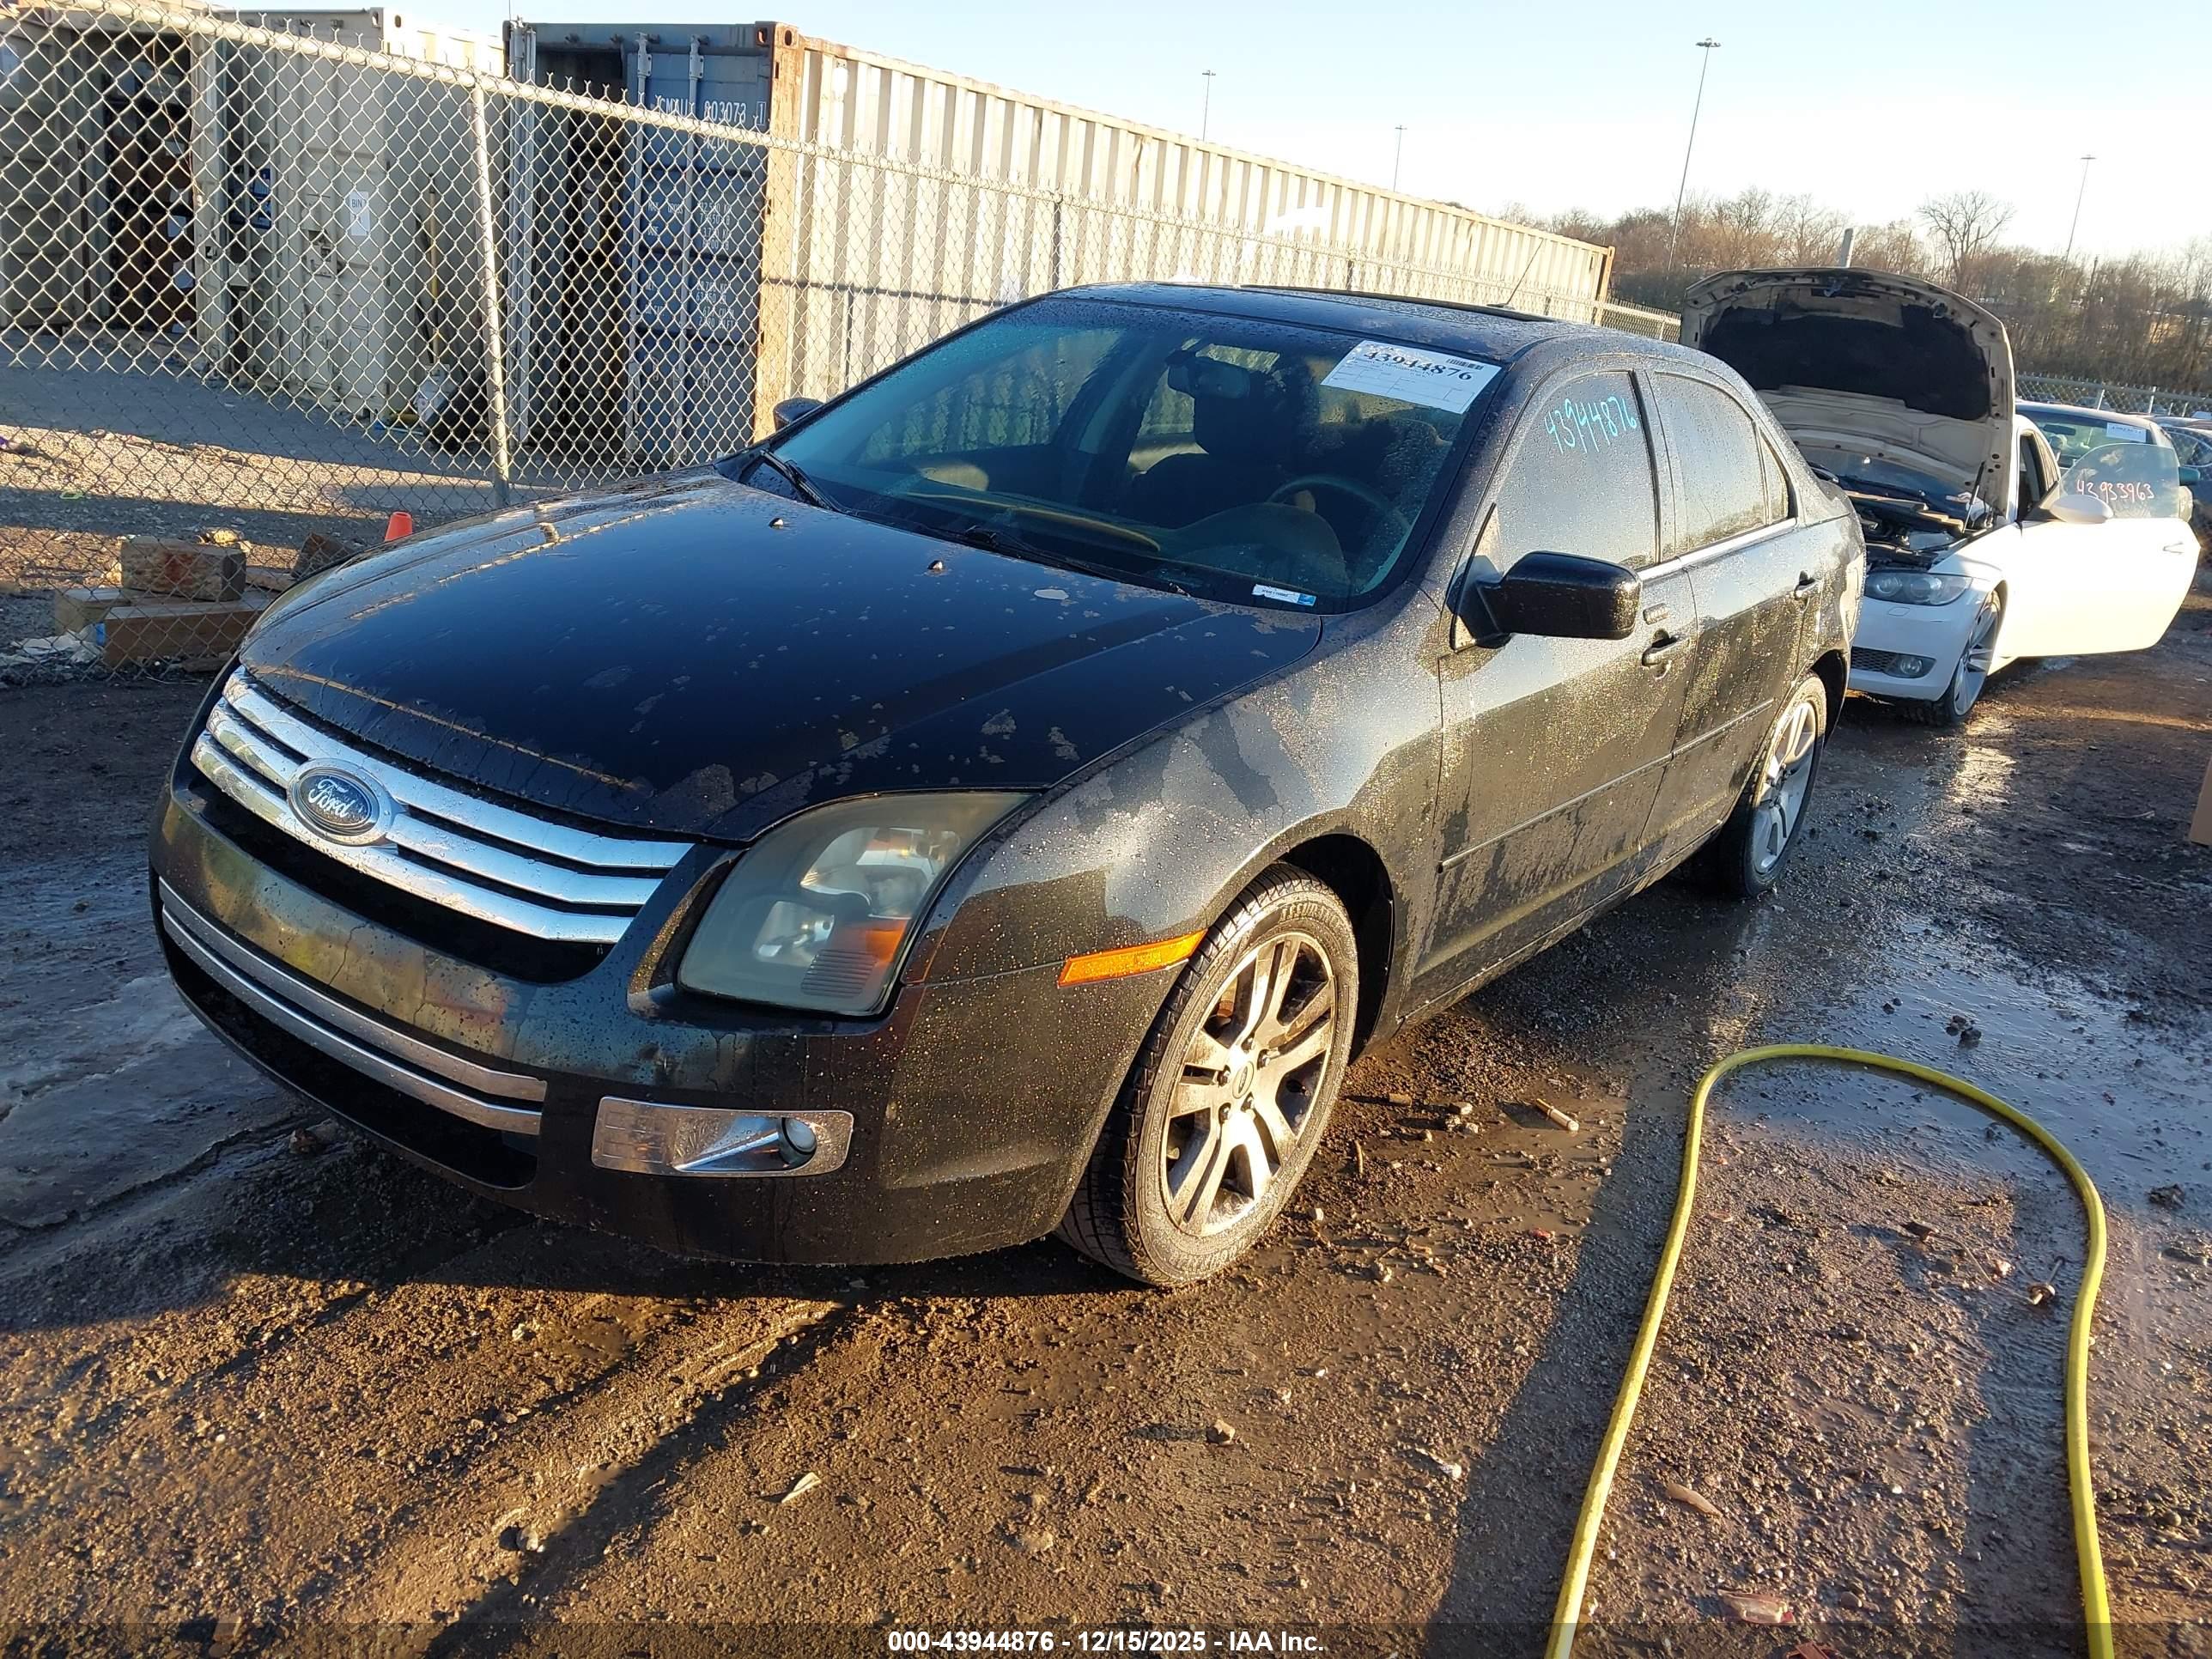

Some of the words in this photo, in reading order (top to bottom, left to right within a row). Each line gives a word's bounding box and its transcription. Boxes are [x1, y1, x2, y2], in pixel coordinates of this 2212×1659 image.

[1364, 351, 1473, 380] 43944876
[1544, 396, 1638, 454] 43944876
[307, 778, 356, 818] Ford
